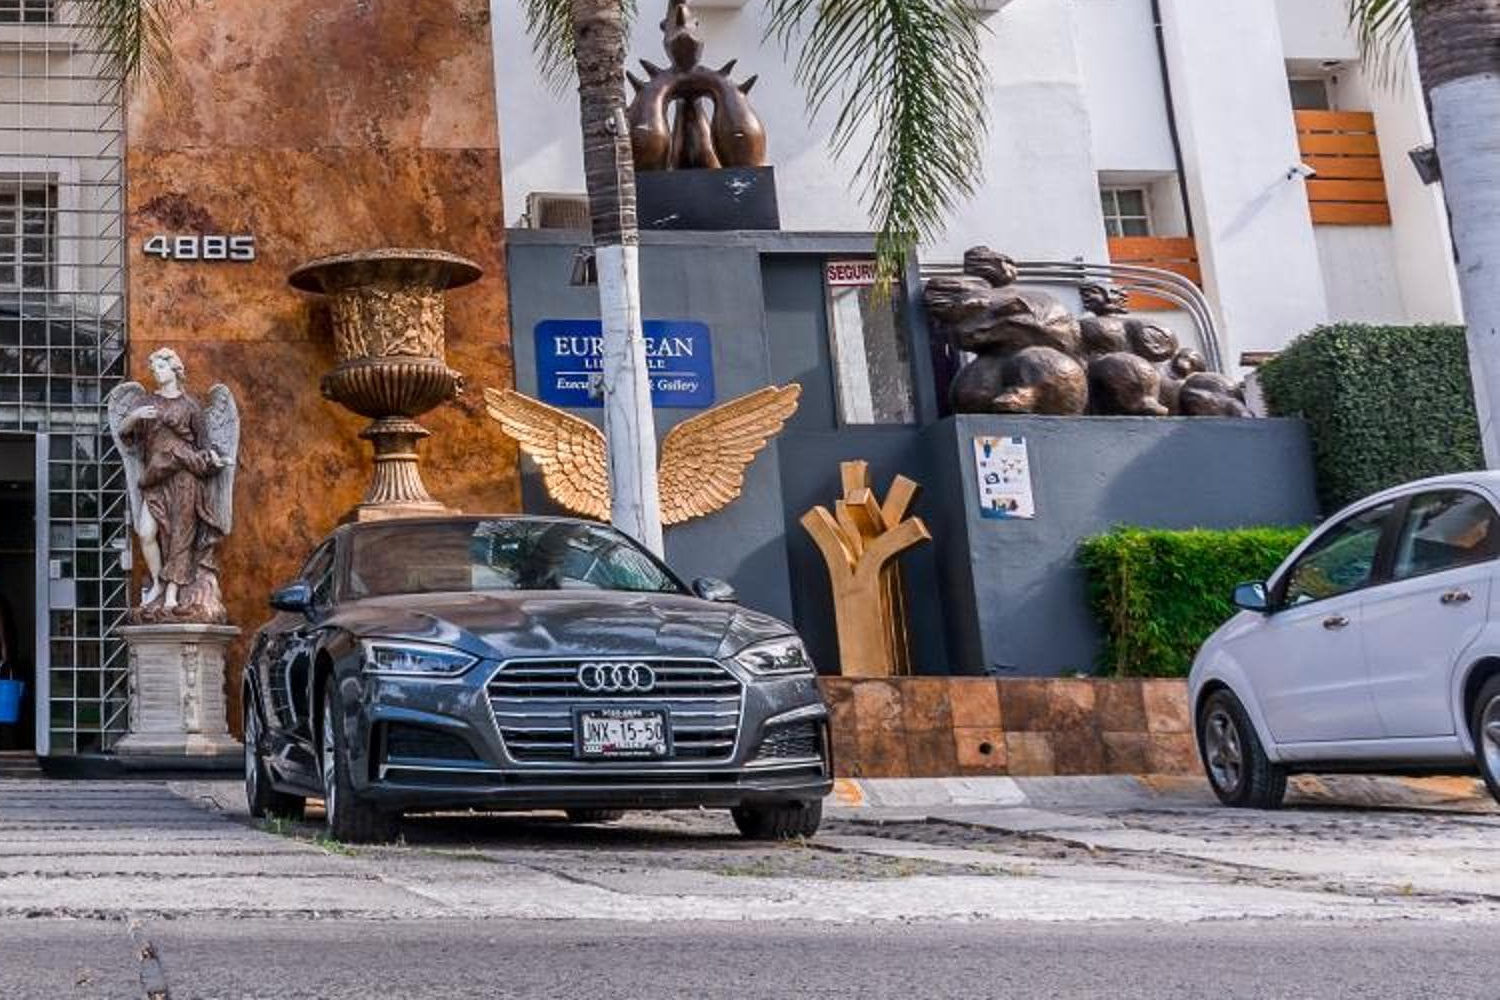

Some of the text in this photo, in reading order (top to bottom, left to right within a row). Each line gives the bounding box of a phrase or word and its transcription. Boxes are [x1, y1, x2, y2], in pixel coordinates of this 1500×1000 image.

[143, 235, 256, 260] 4885
[827, 263, 876, 280] SEGURI
[554, 337, 693, 357] EUREAN
[657, 379, 699, 393] Gallery
[584, 722, 662, 742] JNX-15-50
